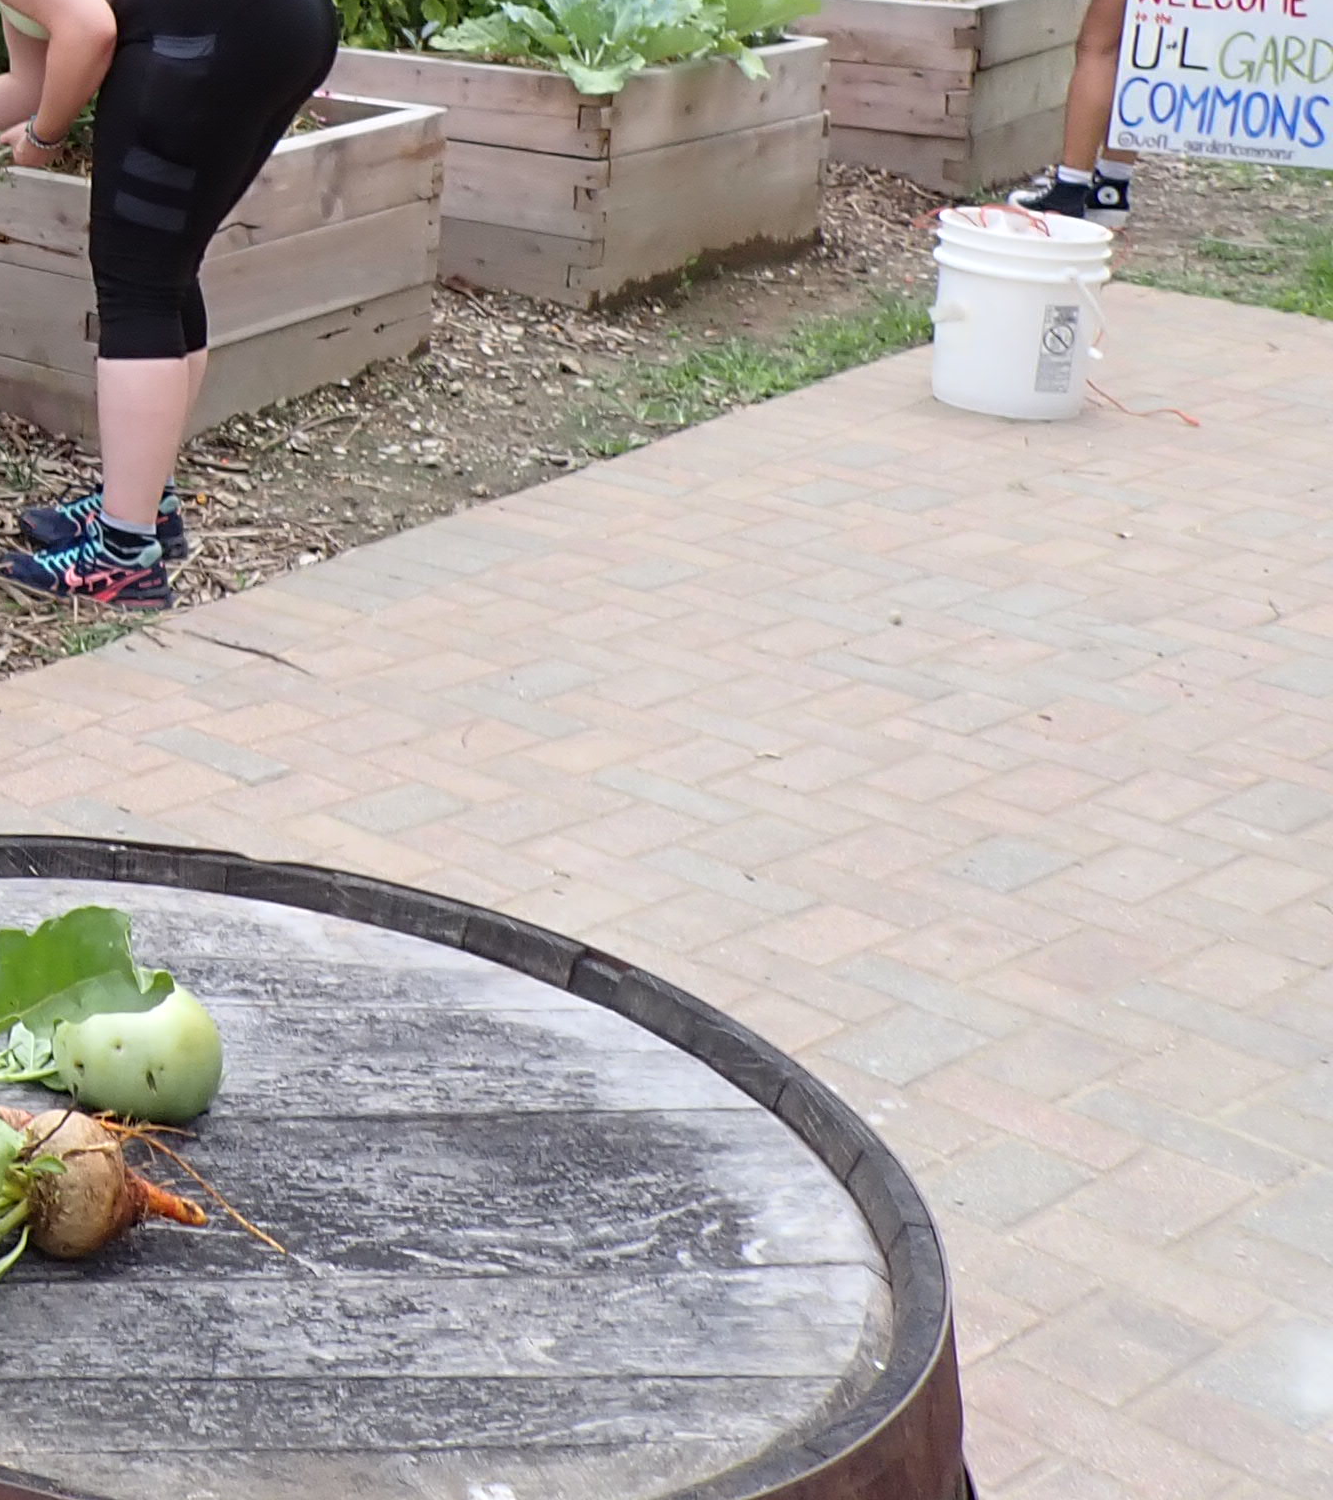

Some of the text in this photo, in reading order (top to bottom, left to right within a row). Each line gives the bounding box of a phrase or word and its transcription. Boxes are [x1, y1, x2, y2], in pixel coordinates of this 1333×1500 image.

[1131, 23, 1164, 69] U
[1179, 26, 1209, 71] L
[1218, 31, 1333, 85] GARD
[1117, 76, 1331, 148] COMMONS
